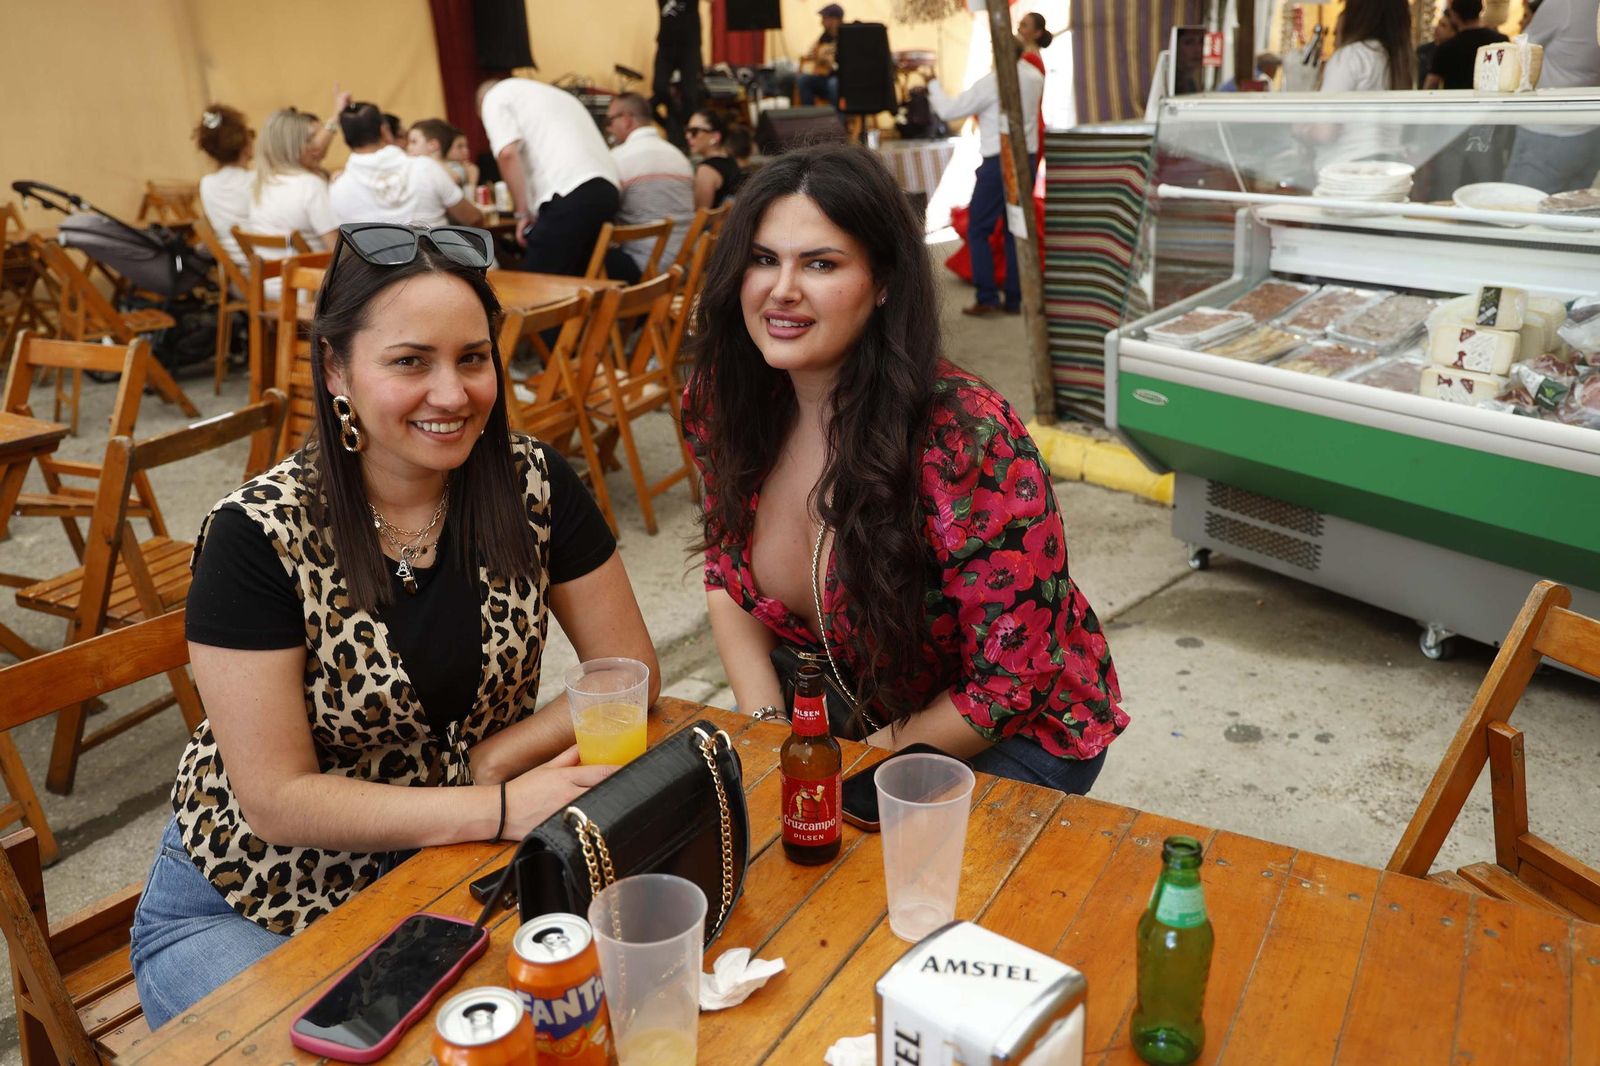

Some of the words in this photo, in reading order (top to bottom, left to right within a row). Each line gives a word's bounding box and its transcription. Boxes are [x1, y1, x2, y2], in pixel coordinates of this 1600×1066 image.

[784, 815, 836, 830] Cruzcampo
[794, 833, 824, 841] PILSEN
[921, 956, 1038, 982] AMSTEL
